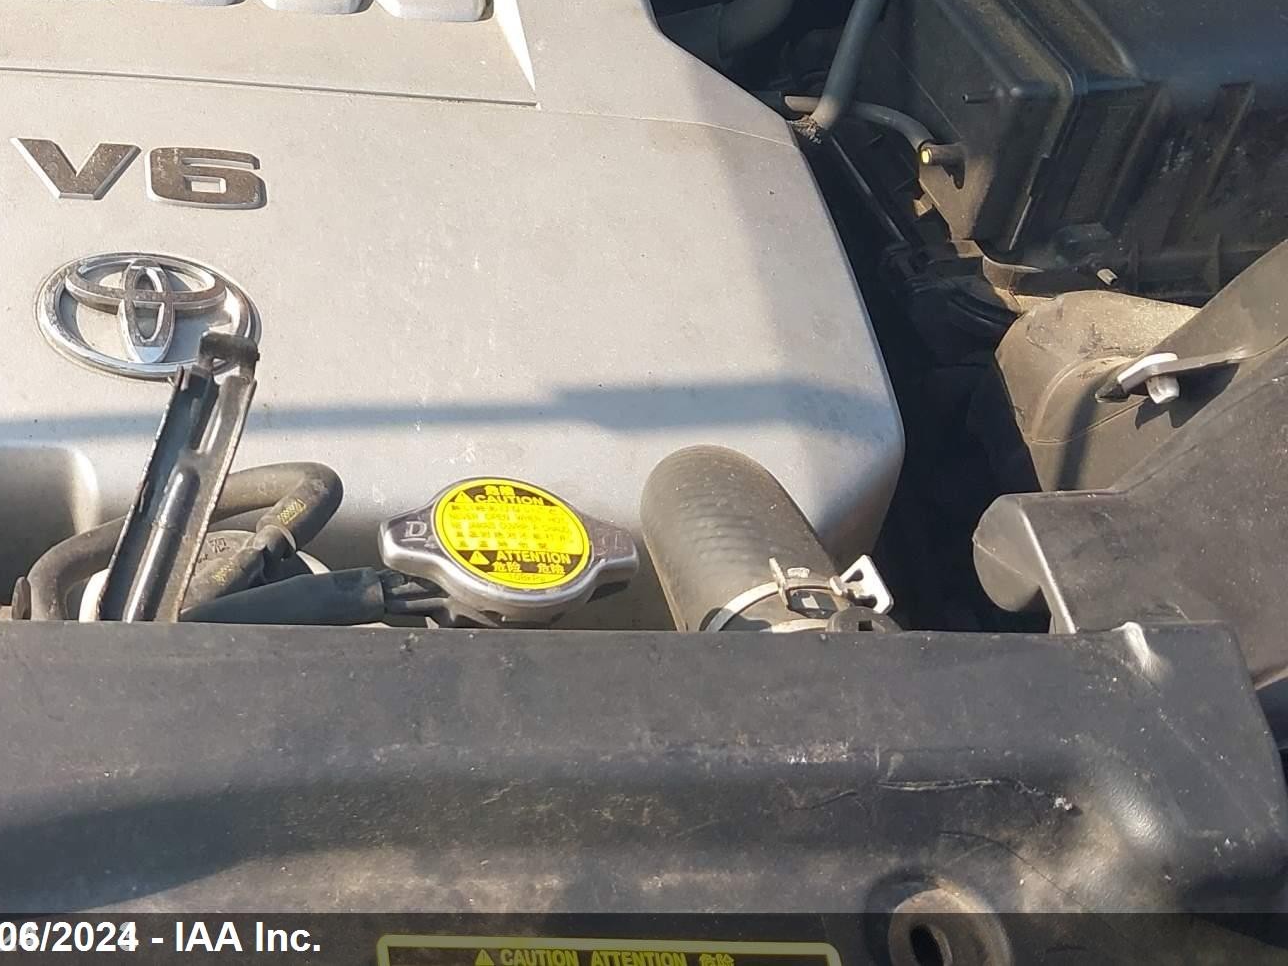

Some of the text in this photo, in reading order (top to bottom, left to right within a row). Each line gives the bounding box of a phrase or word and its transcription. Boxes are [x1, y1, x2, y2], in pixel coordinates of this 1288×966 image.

[9, 137, 269, 211] V6
[474, 494, 544, 506] CAUTION
[496, 550, 571, 564] ATTENTION
[500, 949, 579, 966] CAUTION
[591, 951, 688, 966] ATTENTION
